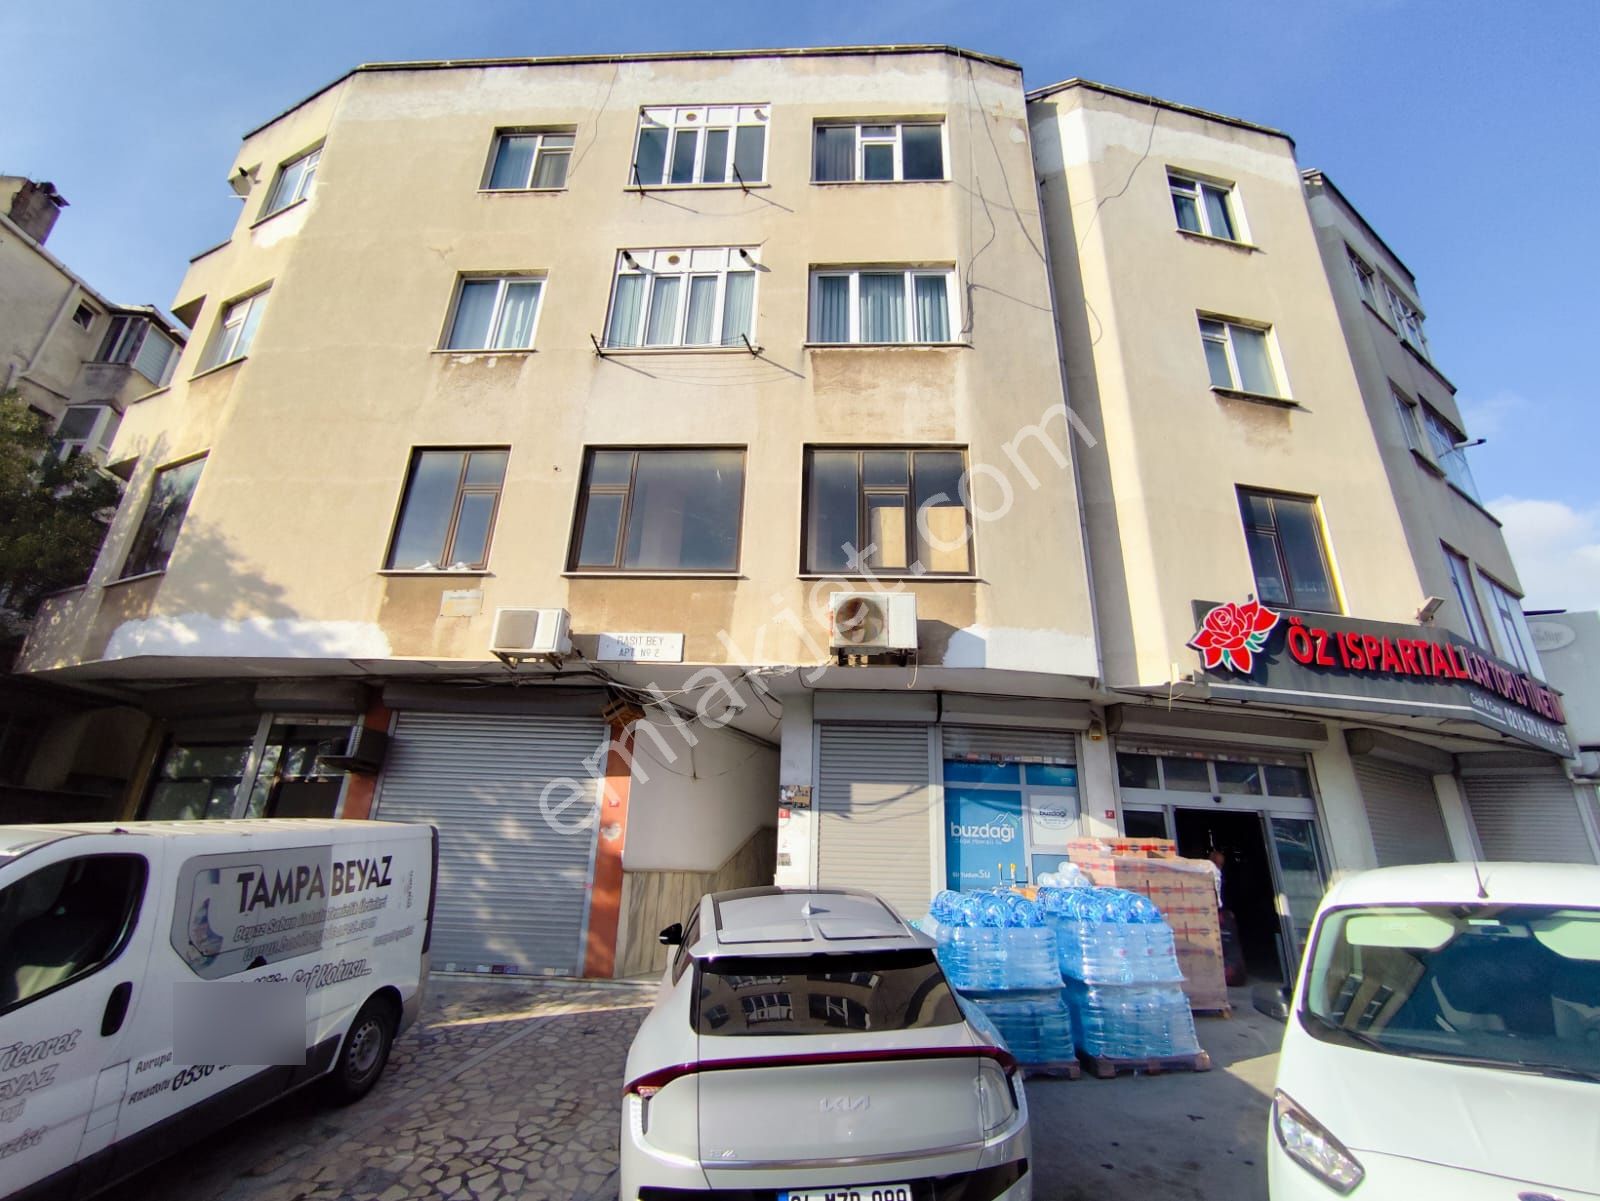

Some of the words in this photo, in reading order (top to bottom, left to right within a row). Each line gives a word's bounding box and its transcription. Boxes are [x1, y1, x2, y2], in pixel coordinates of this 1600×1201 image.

[1288, 615, 1336, 665] ÖZ
[950, 820, 1015, 843] buzdağı
[236, 863, 325, 914] TAMPA
[331, 855, 393, 897] BEYAZ
